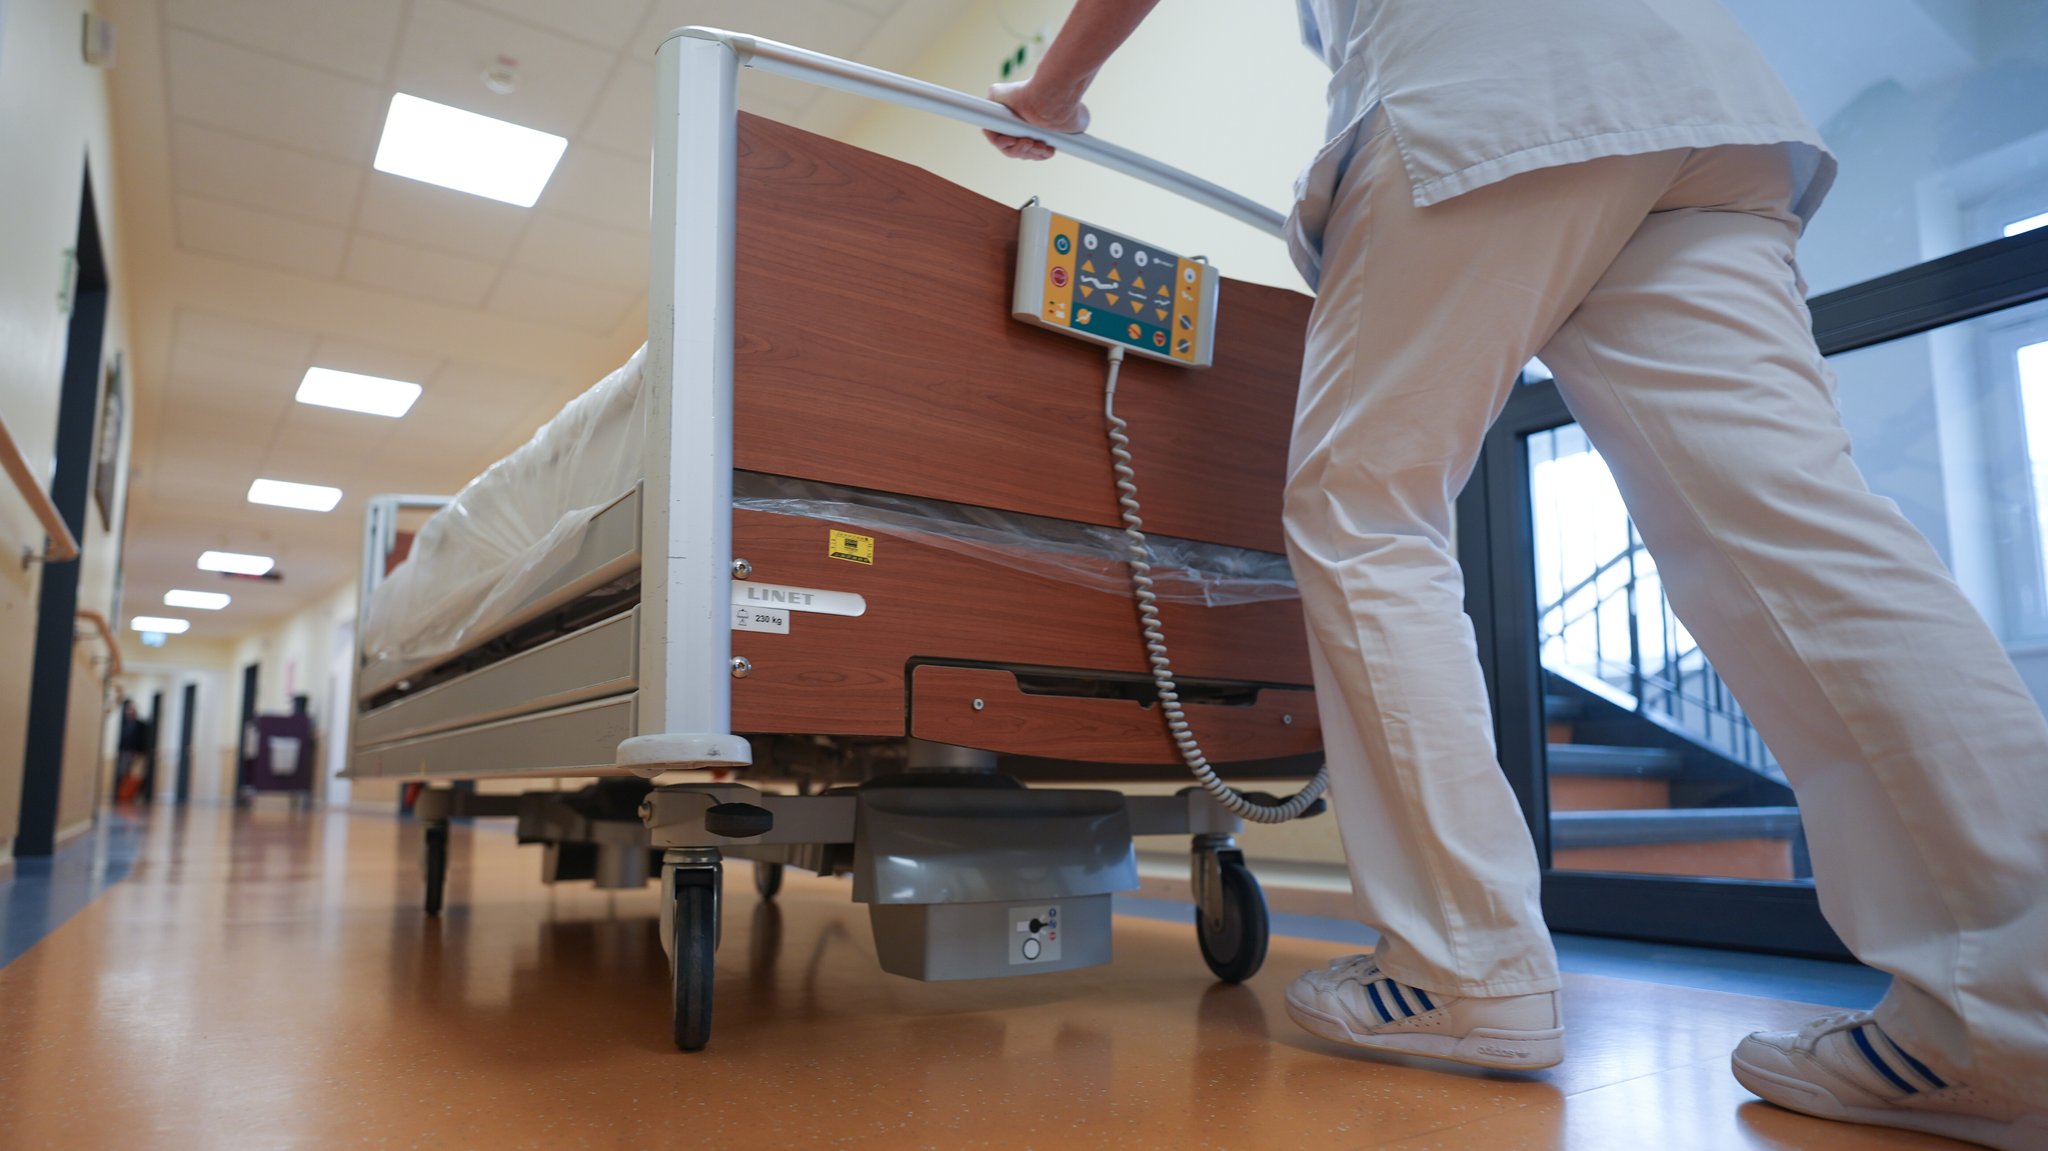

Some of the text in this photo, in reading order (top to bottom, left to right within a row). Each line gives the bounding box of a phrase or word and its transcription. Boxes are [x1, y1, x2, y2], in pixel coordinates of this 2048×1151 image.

[747, 587, 815, 605] LINET
[755, 614, 783, 626] 230 kg
